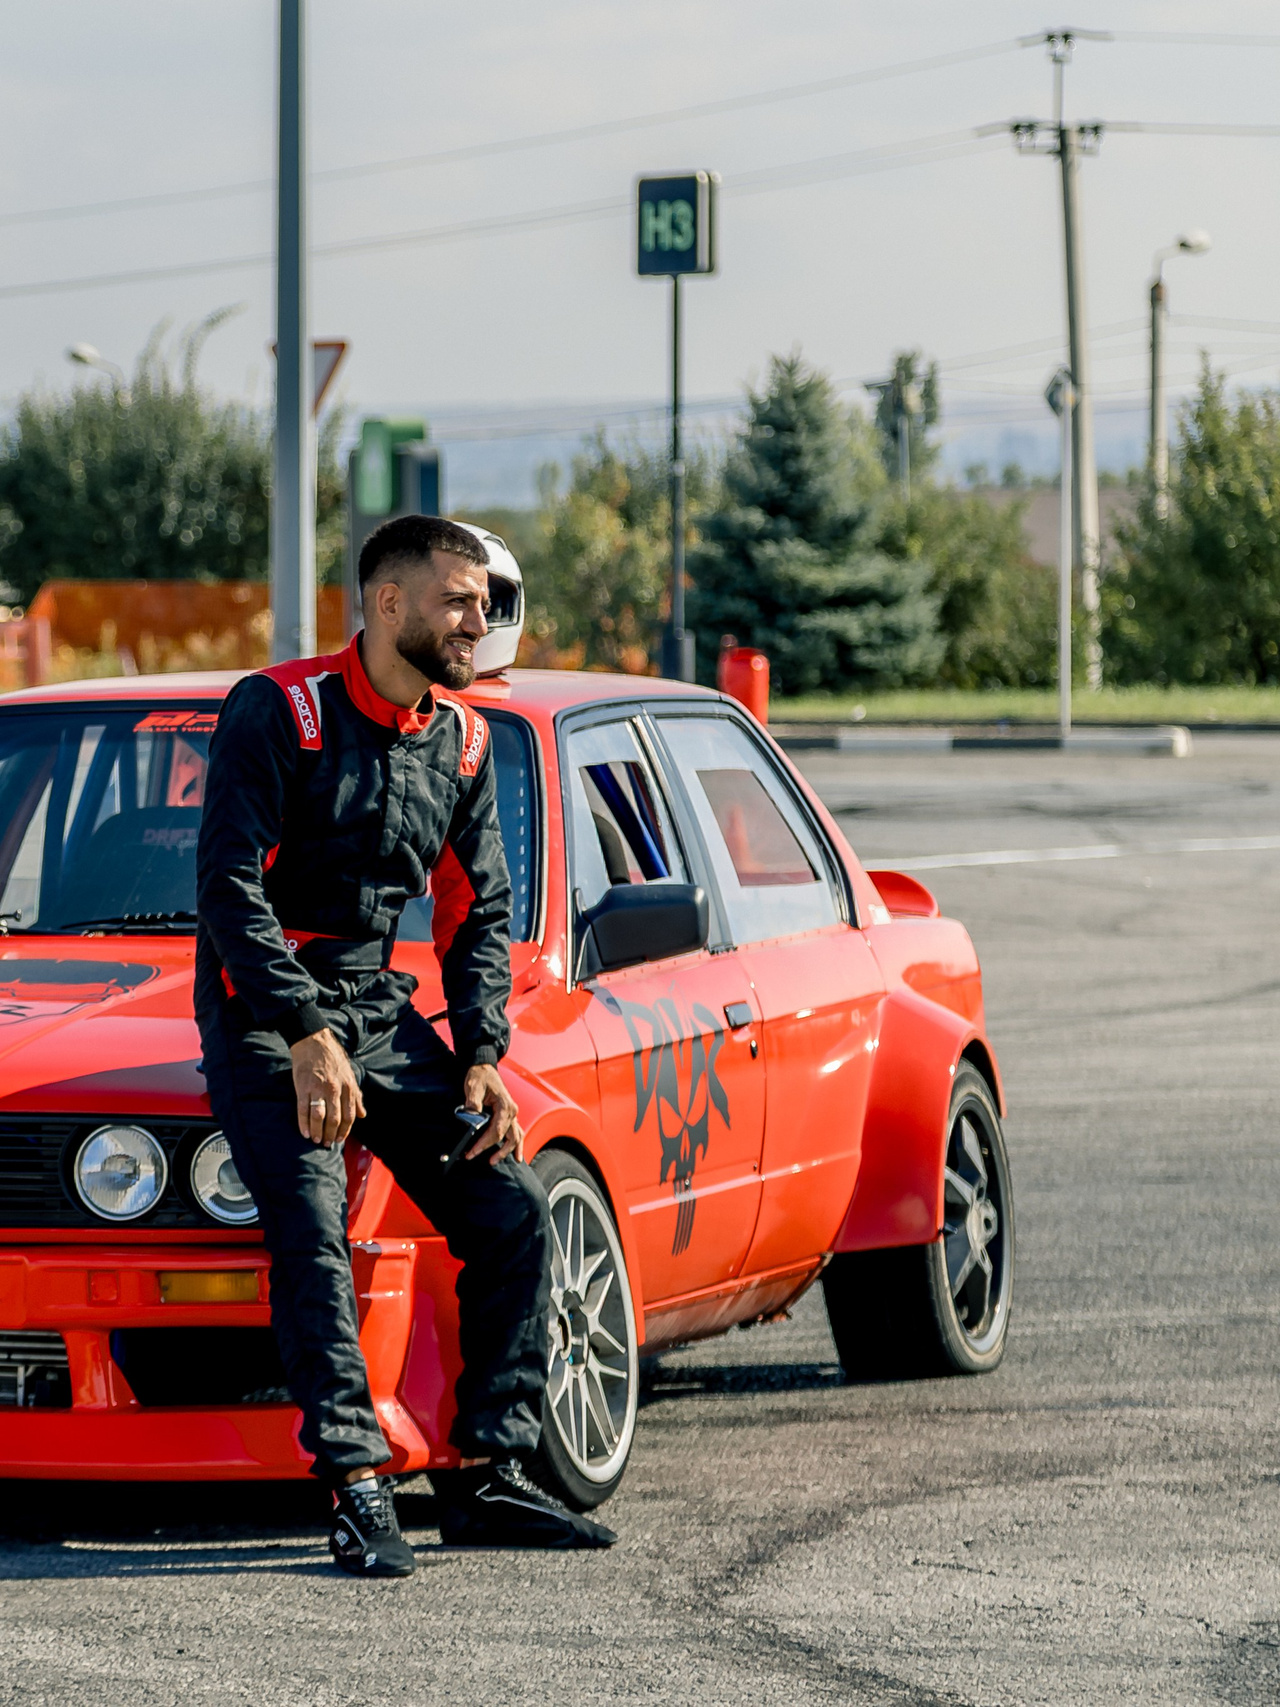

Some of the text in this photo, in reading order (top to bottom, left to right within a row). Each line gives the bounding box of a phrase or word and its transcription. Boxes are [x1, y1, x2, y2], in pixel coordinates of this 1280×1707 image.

[642, 199, 694, 252] H3
[287, 684, 318, 741] sparco
[466, 715, 485, 766] sparco
[143, 828, 197, 845] DRIFT
